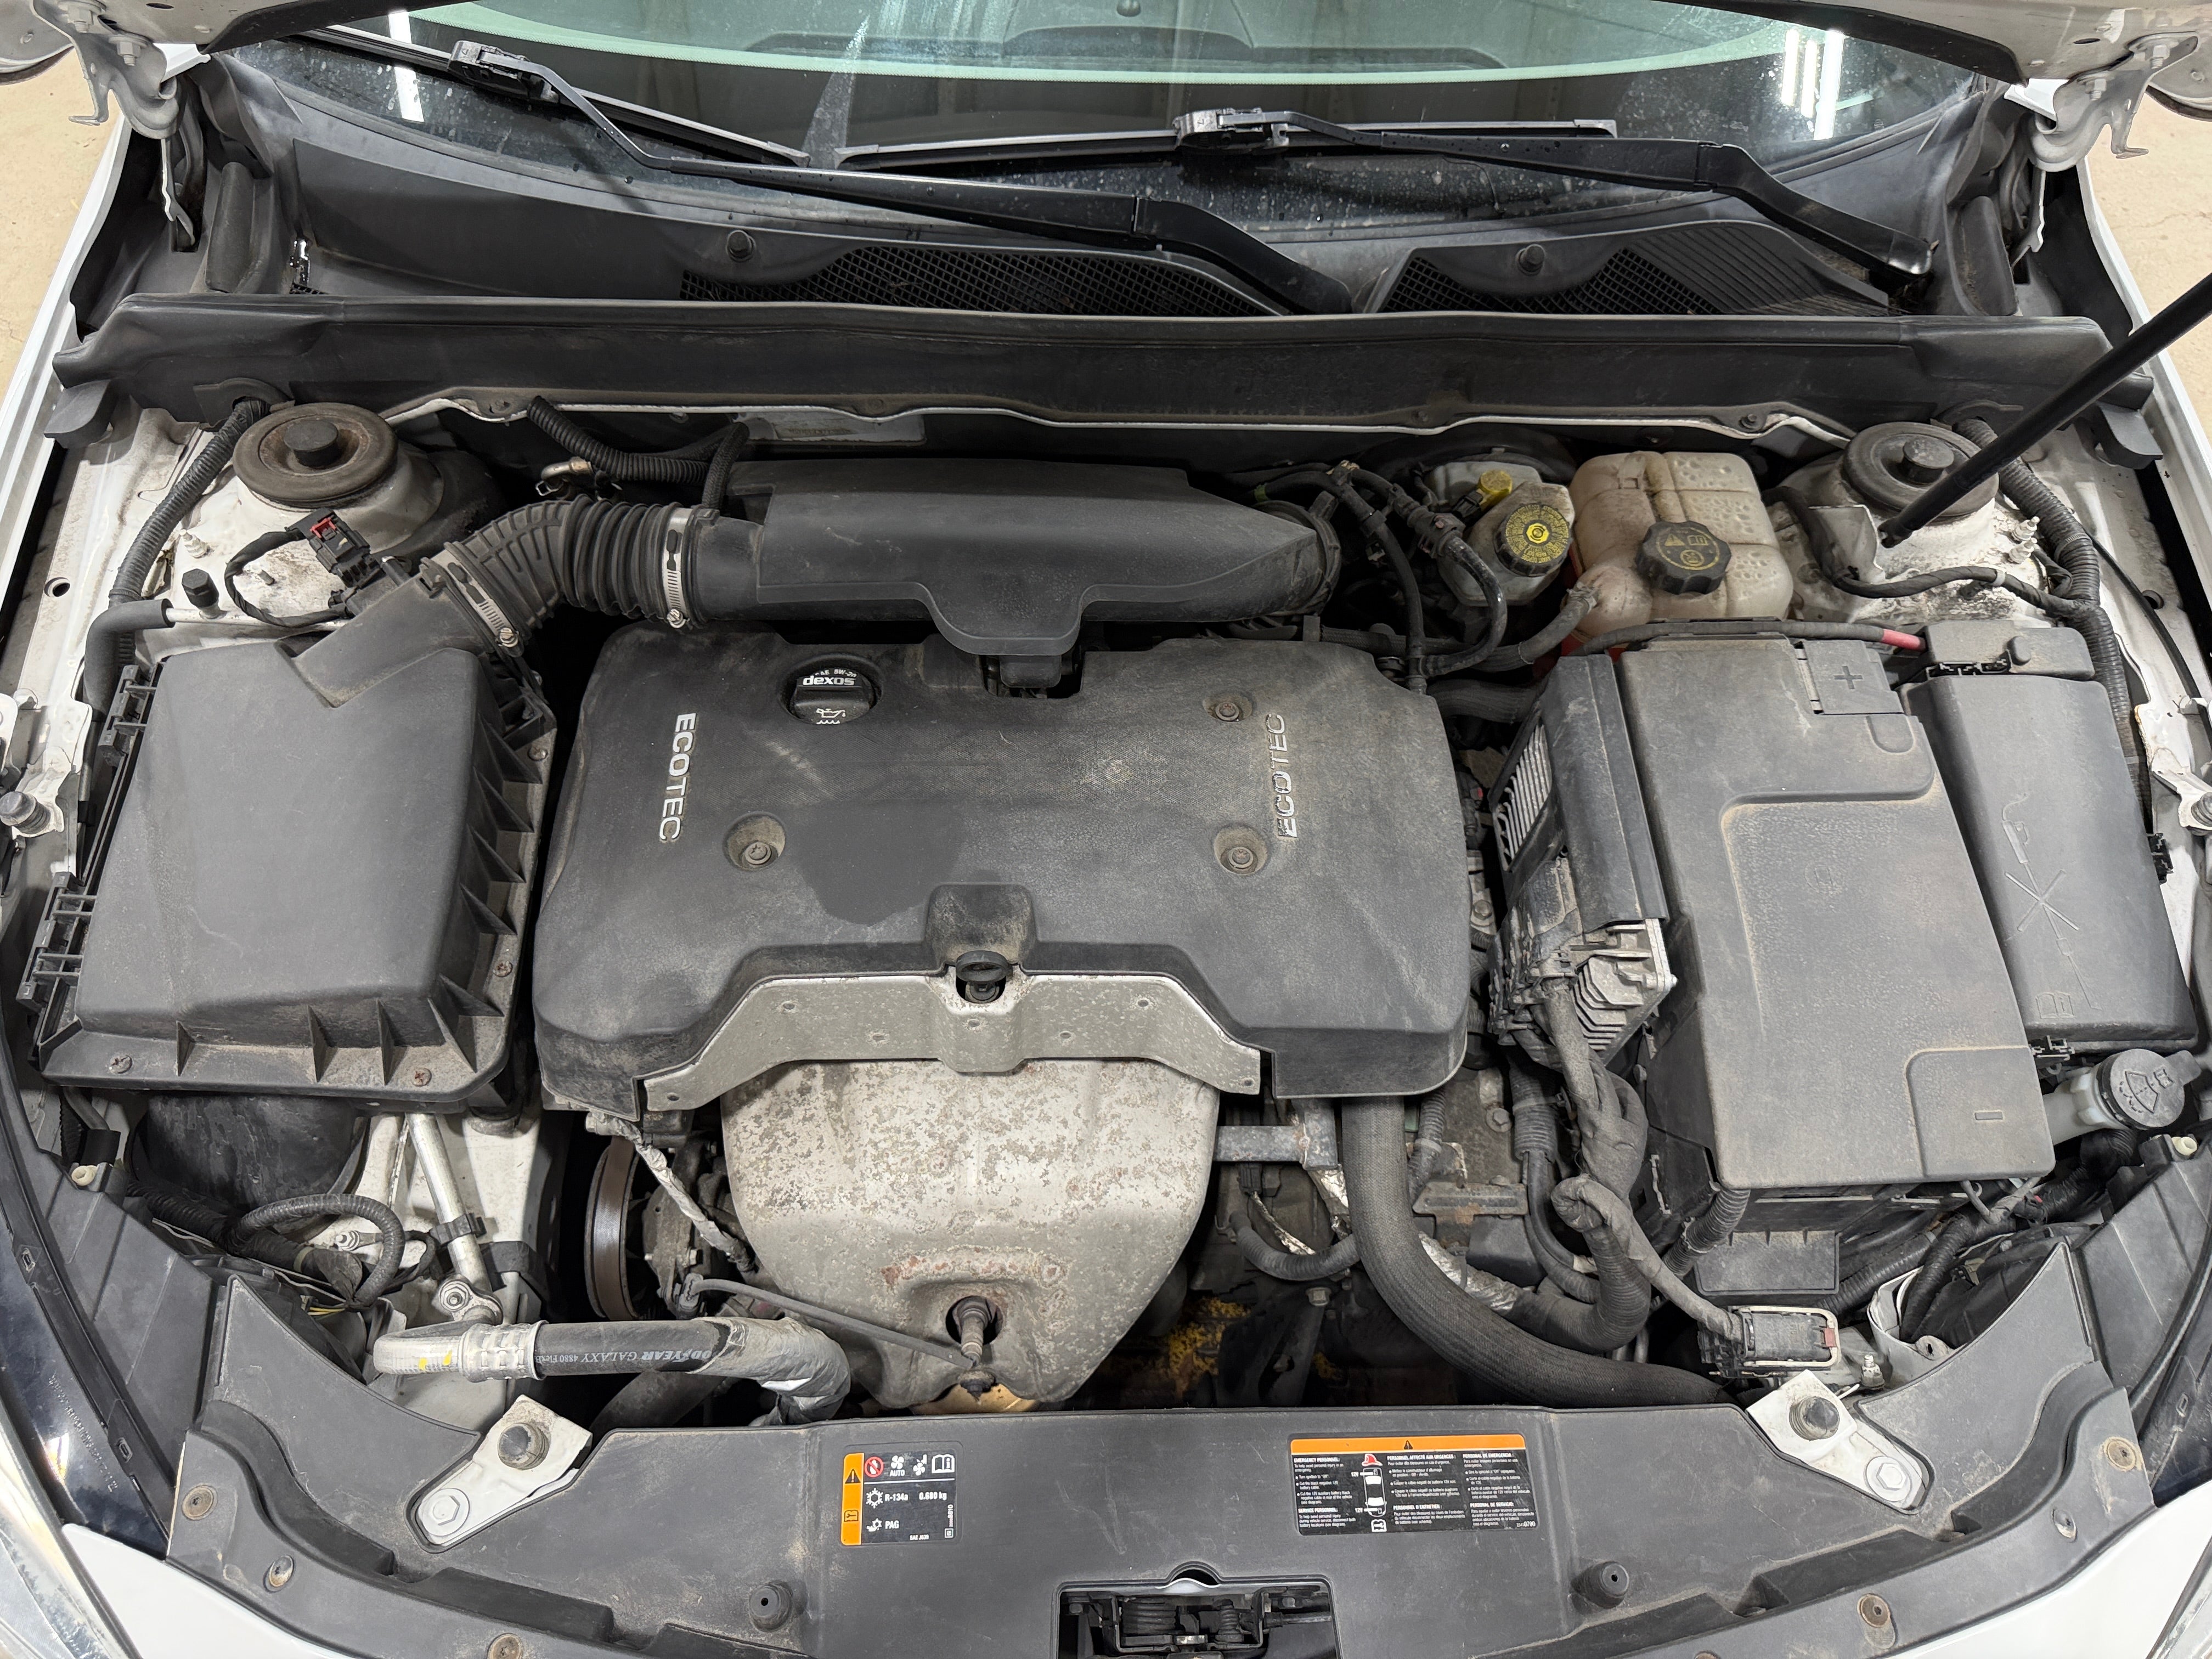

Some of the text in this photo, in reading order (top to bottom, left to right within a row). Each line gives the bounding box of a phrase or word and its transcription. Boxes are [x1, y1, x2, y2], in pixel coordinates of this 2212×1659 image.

[803, 675, 856, 686] dexos
[659, 713, 697, 840] ECOTEC
[1265, 713, 1297, 838] ECOTEC
[560, 1354, 578, 1363] 4880
[580, 1351, 637, 1363] GALAXY
[884, 1493, 909, 1502] R-134a
[939, 1491, 947, 1501] kg
[885, 1520, 900, 1529] PAG
